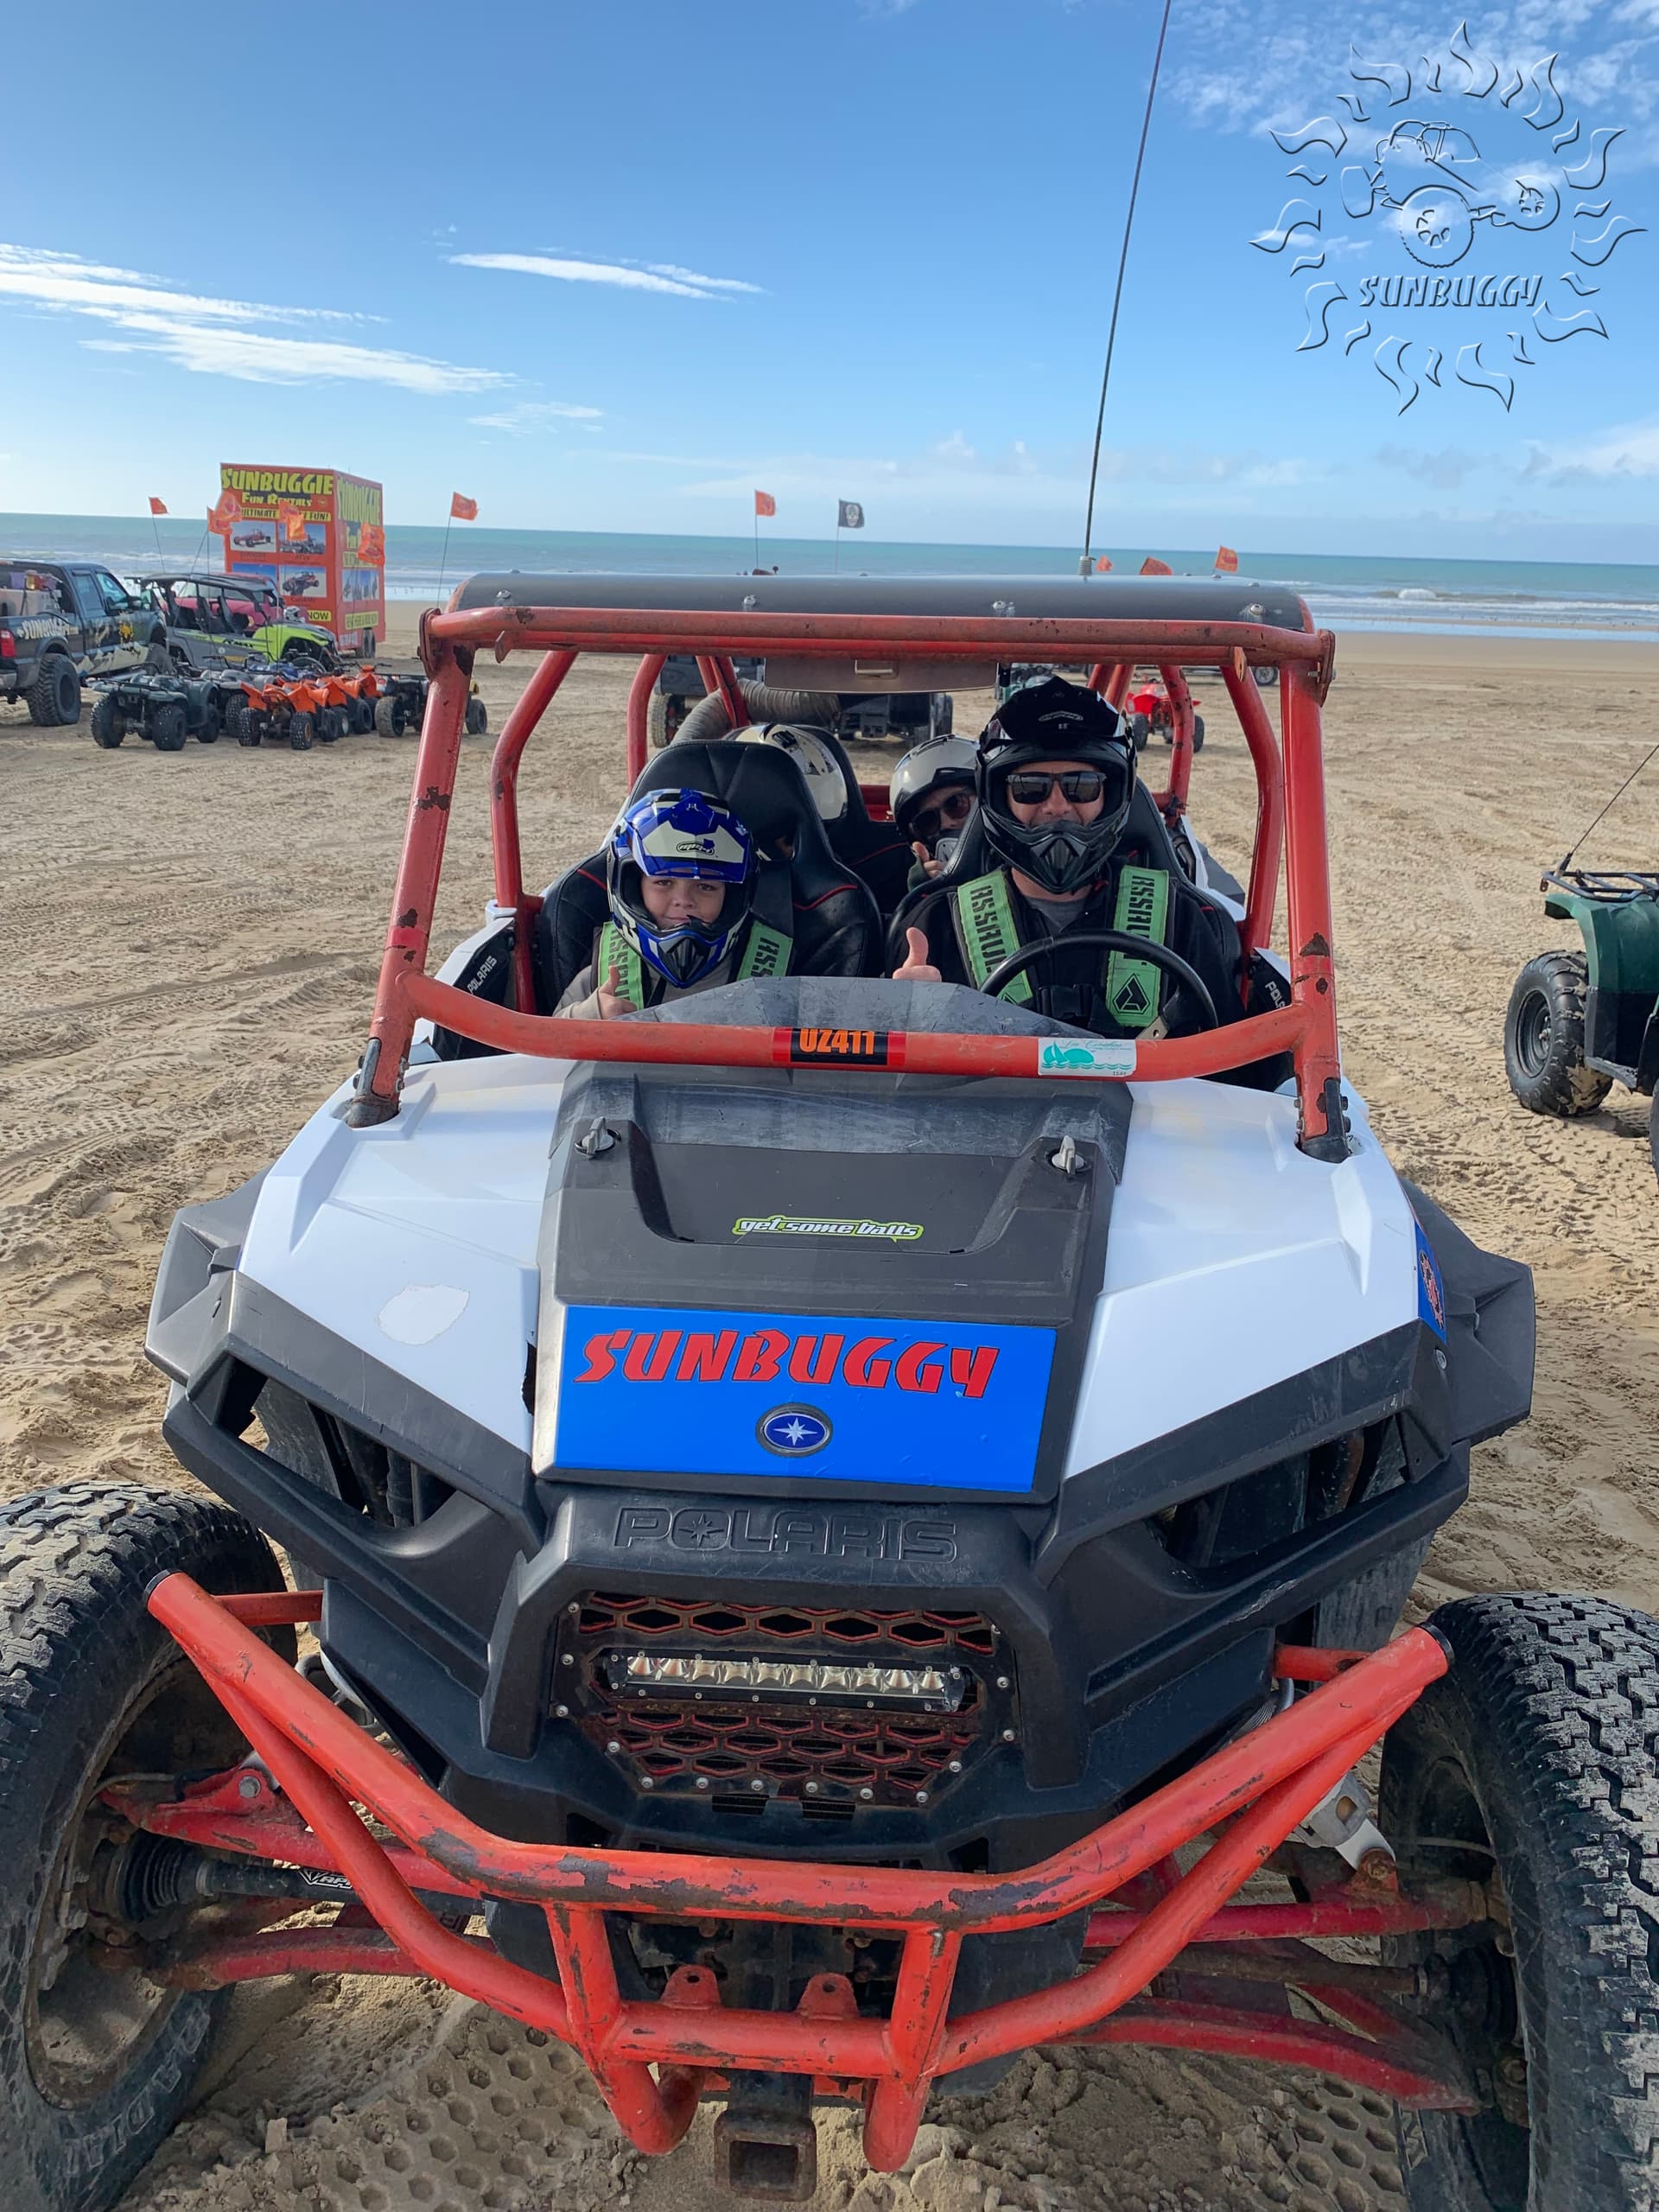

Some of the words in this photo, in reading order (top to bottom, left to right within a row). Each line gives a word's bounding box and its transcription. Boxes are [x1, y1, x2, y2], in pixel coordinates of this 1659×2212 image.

[221, 468, 334, 495] SUNBUGGIE
[969, 885, 1007, 974] ASSAUL
[467, 955, 498, 995] POLARIS
[798, 1028, 875, 1055] UZ411
[739, 1218, 780, 1232] get
[781, 1223, 853, 1235] some
[856, 1223, 918, 1236] balls
[573, 1328, 1001, 1399] SUNBUGGY
[613, 1506, 958, 1565] POLARIS
